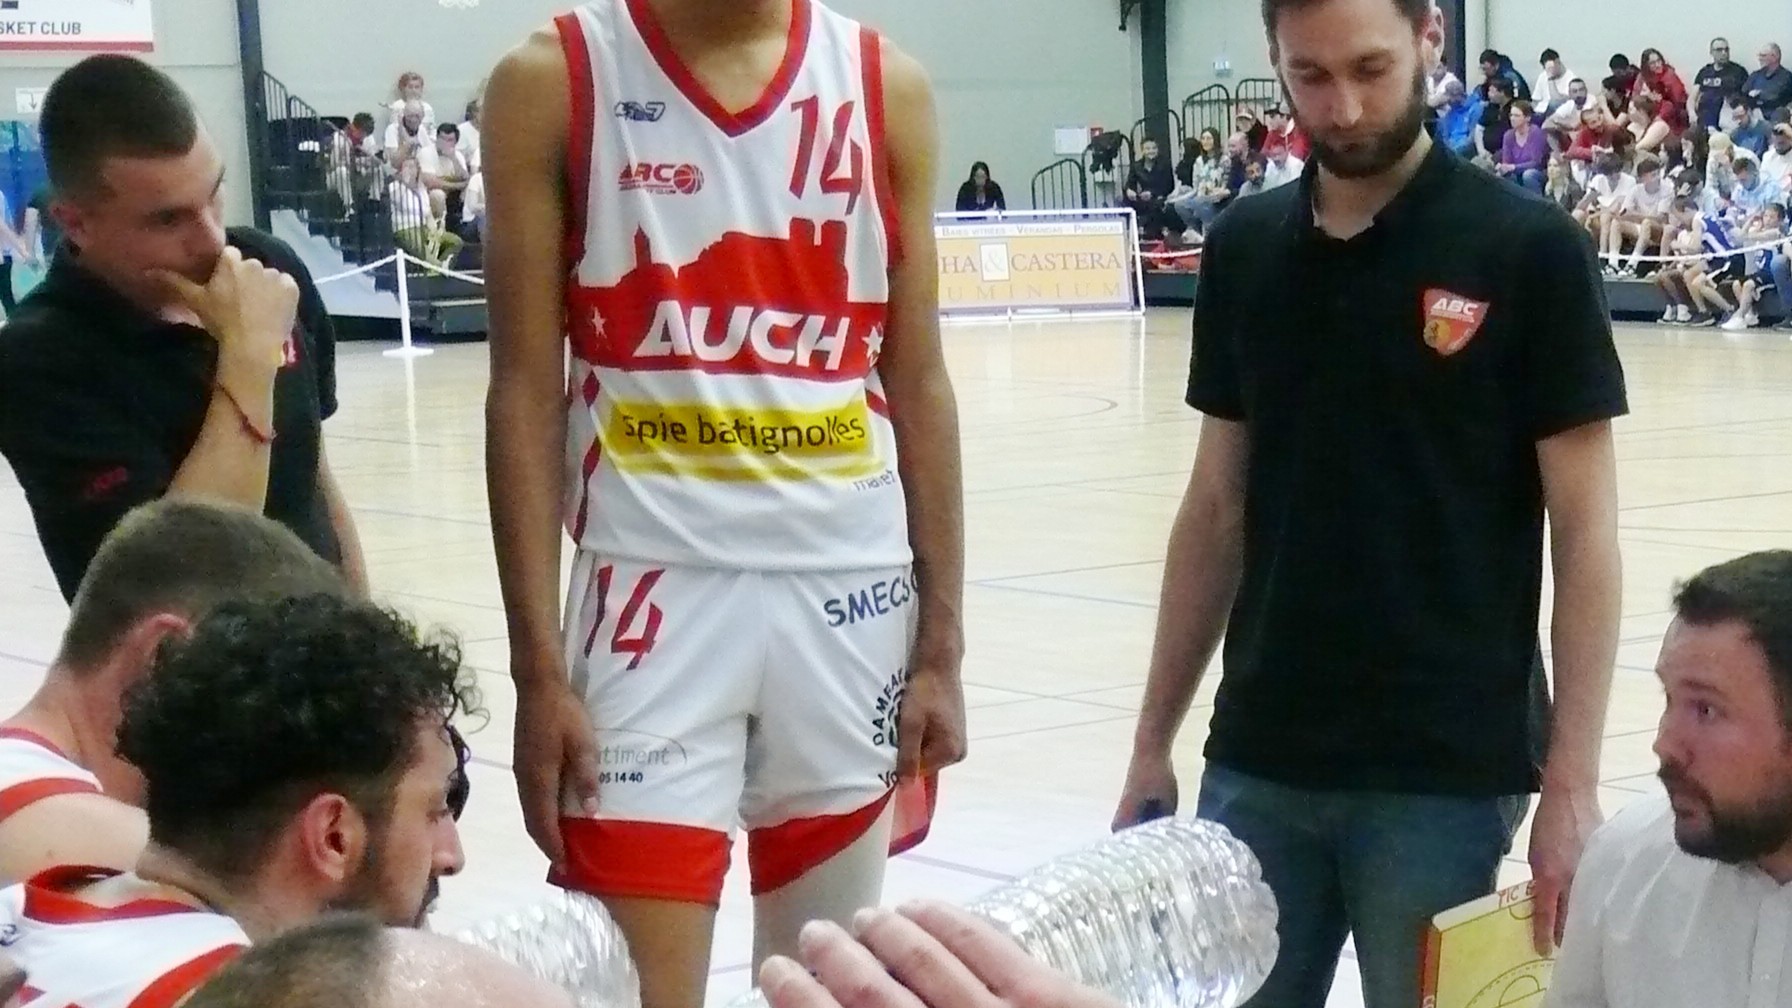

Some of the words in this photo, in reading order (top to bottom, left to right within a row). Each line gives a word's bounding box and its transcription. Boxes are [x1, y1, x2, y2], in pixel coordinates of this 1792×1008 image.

[40, 21, 82, 35] CLUB
[789, 94, 863, 216] 14
[1011, 251, 1123, 272] CASTERA
[1431, 297, 1478, 316] ABC
[631, 299, 851, 371] AUCH
[622, 413, 687, 444] spie
[697, 412, 866, 454] batignolles
[584, 564, 667, 672] 14
